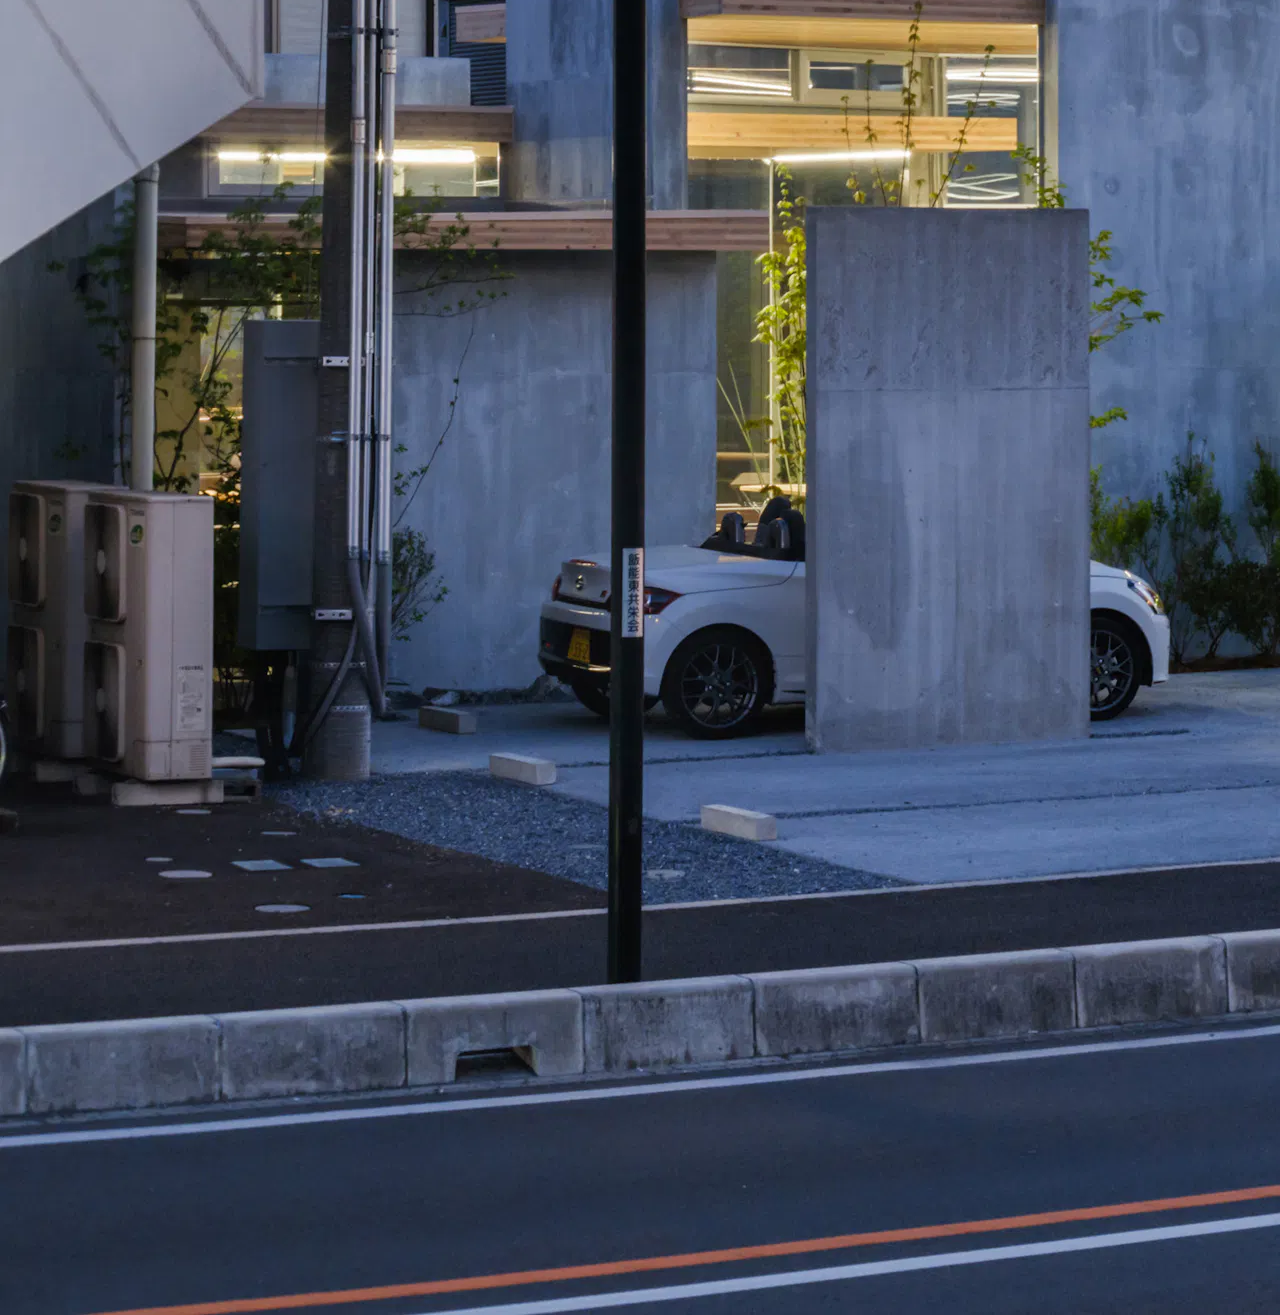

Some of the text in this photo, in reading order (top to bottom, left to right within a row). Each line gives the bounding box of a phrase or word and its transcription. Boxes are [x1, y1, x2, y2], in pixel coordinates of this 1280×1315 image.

[627, 553, 640, 633] 飯能東共栄会
